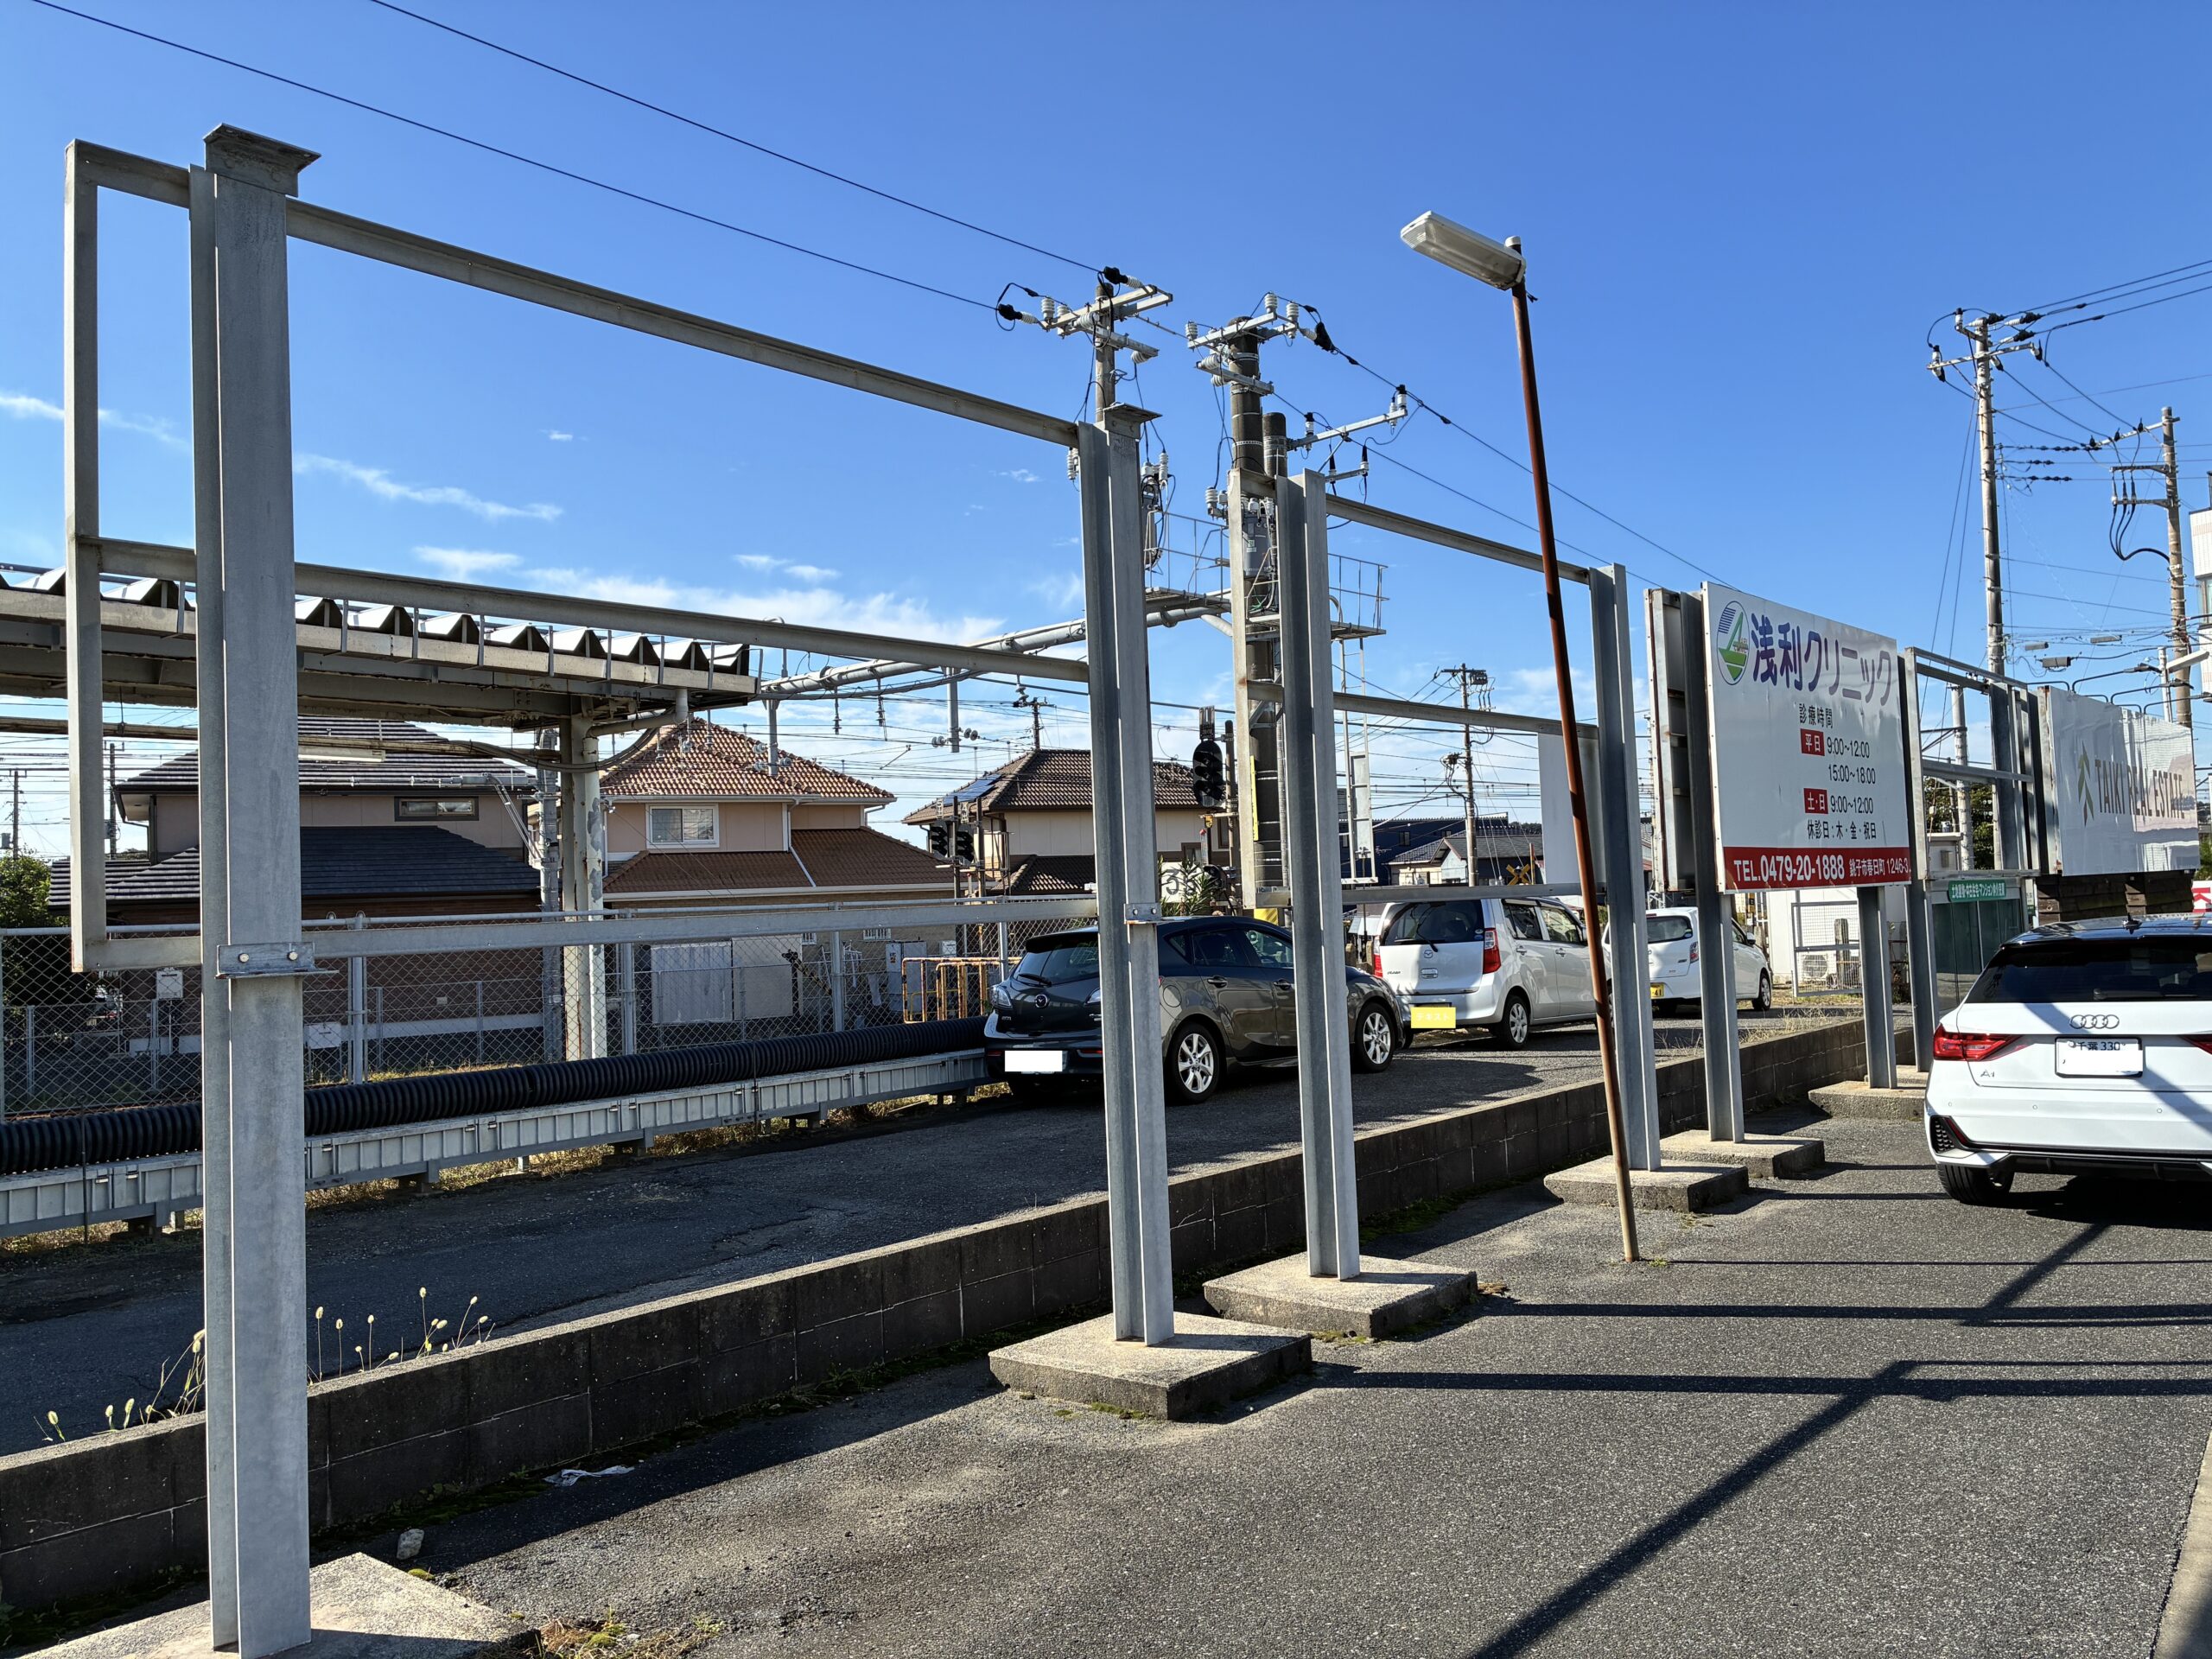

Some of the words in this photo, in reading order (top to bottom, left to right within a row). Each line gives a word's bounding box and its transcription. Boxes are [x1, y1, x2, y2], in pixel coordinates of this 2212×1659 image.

[1751, 613, 1891, 707] 浅利クリニック
[1799, 703, 1834, 728] 診療時間
[1805, 734, 1821, 752] 平日
[2094, 759, 2126, 815] TAIKI
[2127, 765, 2152, 817] REAL
[2152, 769, 2185, 819] ESTATE
[1849, 858, 1885, 877] 銚子市春日町
[1886, 857, 1909, 874] 1246-3
[2100, 1041, 2120, 1051] 330
[1980, 1069, 1995, 1077] A1
